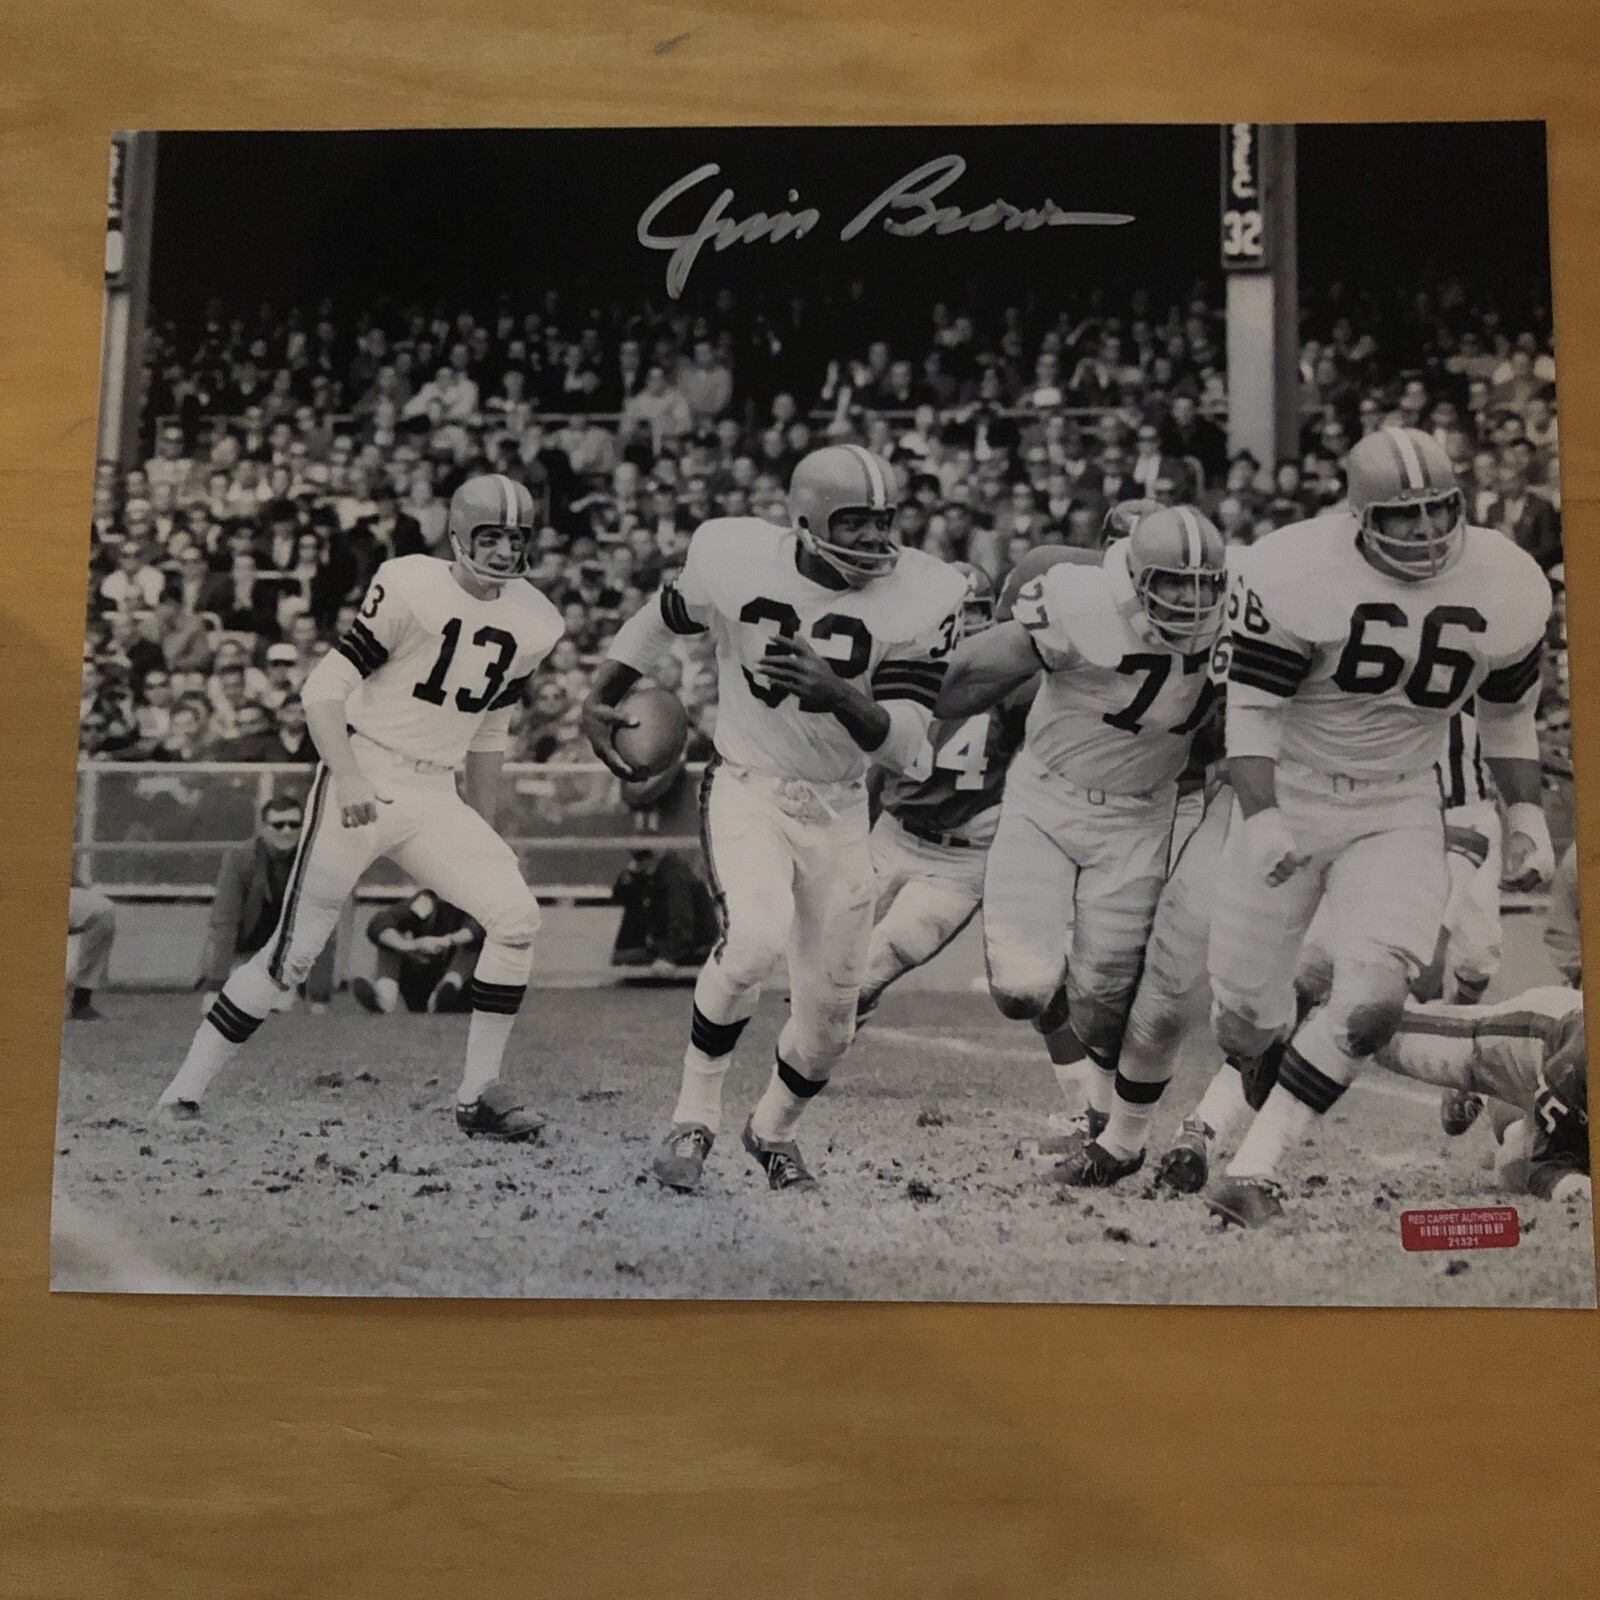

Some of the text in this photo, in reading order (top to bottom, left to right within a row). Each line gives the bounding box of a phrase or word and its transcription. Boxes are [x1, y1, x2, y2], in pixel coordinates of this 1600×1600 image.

[637, 154, 1136, 299] Jim Brown
[1223, 210, 1265, 256] 32
[412, 617, 518, 713] 13
[1332, 602, 1488, 709] 66
[1407, 1211, 1512, 1225] RED CARPET AUTHENTICS
